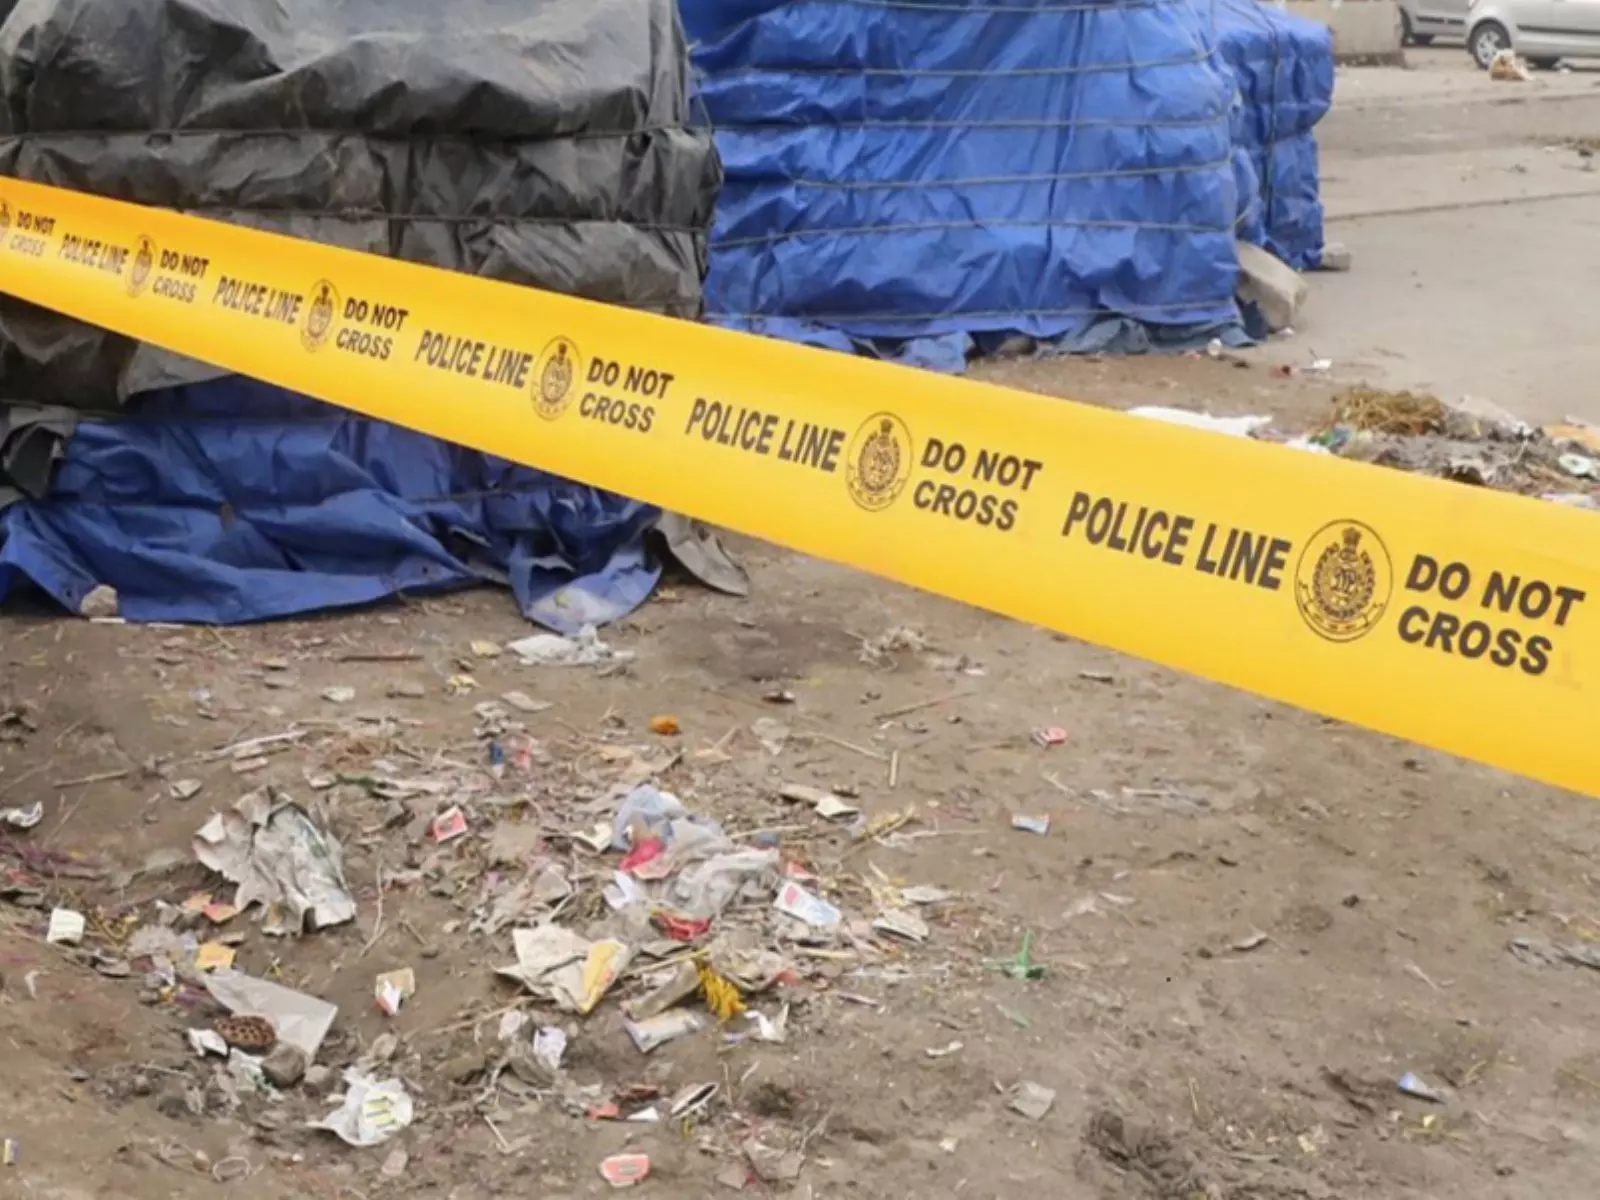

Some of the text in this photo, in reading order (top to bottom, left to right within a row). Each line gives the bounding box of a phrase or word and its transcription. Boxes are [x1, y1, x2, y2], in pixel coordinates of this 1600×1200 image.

[17, 210, 56, 236] DO NOT
[59, 233, 130, 275] POLICE LINE
[160, 249, 209, 279] DO NOT
[153, 276, 197, 303] CROSS
[212, 275, 303, 324] POLICE LINE
[344, 297, 409, 332] DO NOT
[336, 328, 393, 360] CROSS
[414, 329, 534, 388] POLICE LINE
[586, 356, 674, 399] DO NOT
[579, 393, 656, 433] CROSS
[685, 397, 846, 473] POLICE LINE
[921, 437, 1043, 491] DO NOT
[913, 480, 1019, 531] CROSS
[1061, 491, 1292, 591] POLICE LINE
[1404, 553, 1587, 626] DO NOT
[1397, 605, 1553, 676] CROSS
